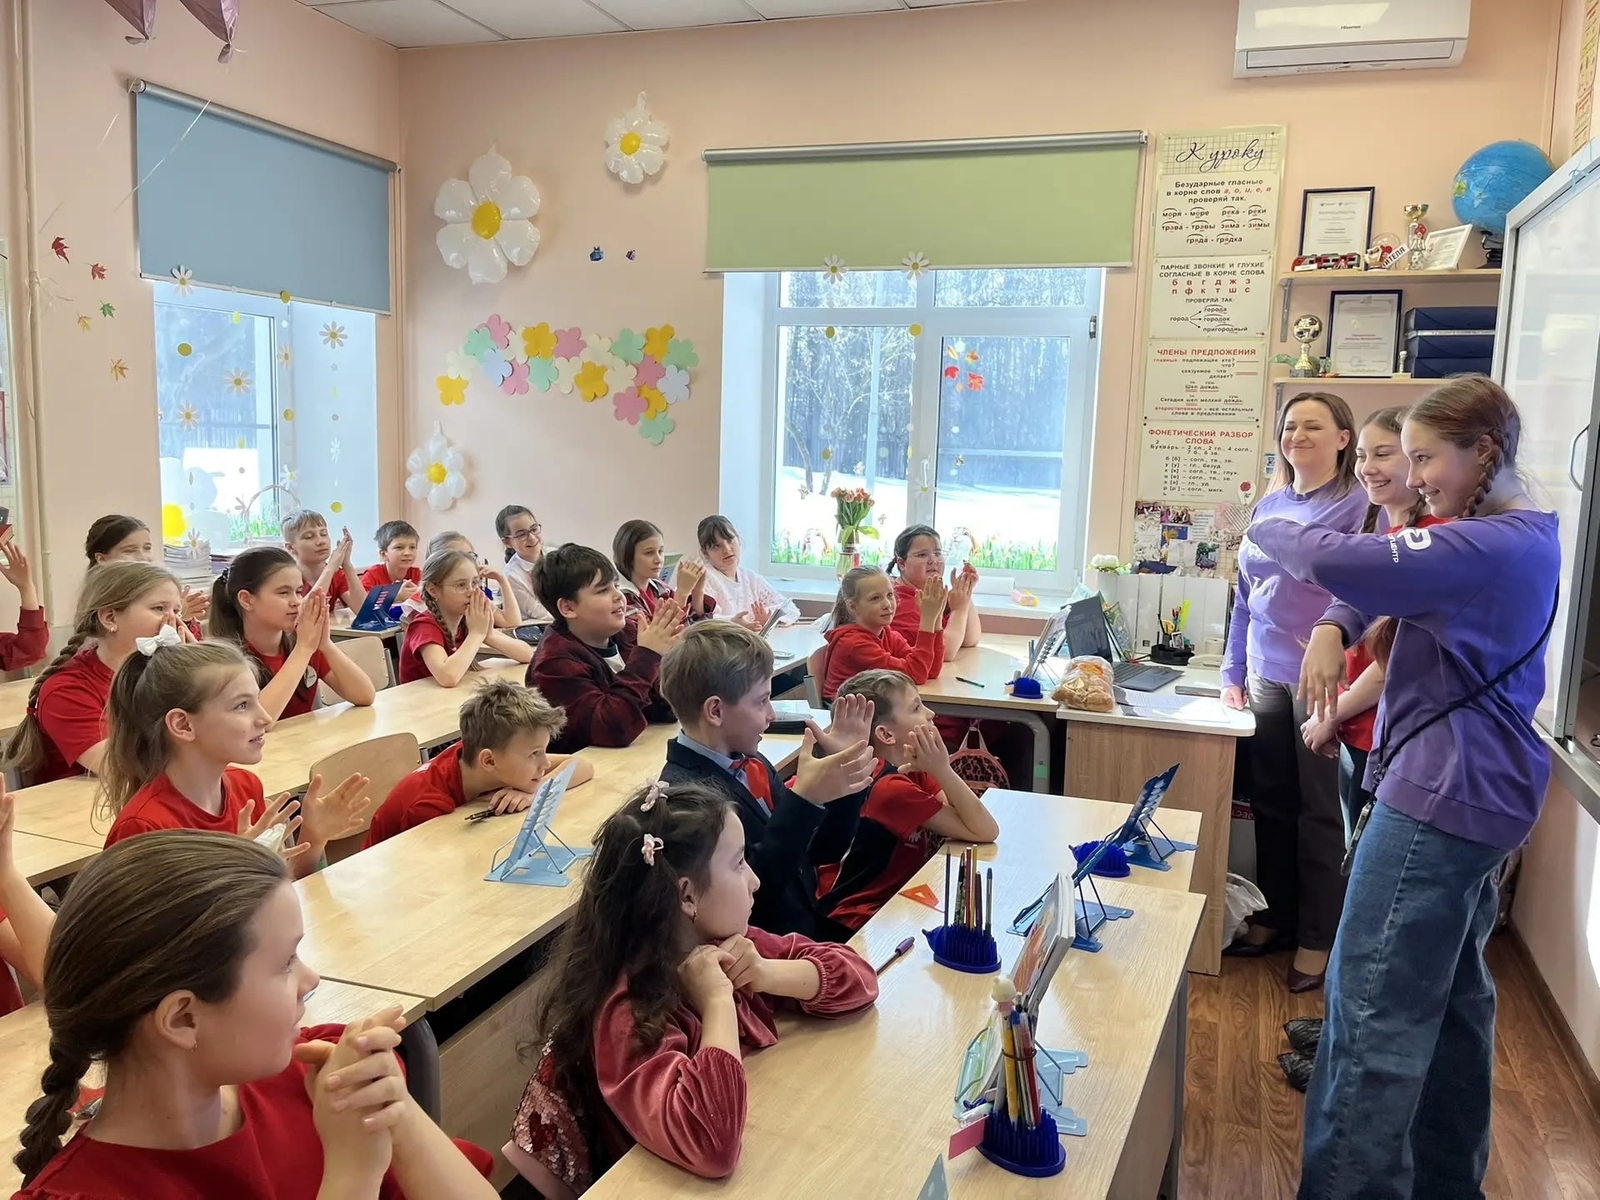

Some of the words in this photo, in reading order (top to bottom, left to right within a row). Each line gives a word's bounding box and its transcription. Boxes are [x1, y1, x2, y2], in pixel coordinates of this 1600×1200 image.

[1175, 142, 1206, 162] К
[1200, 138, 1264, 173] уроку
[1188, 196, 1228, 204] проверяй
[1148, 429, 1216, 437] ФОНЕТИЧЕСКИЙ
